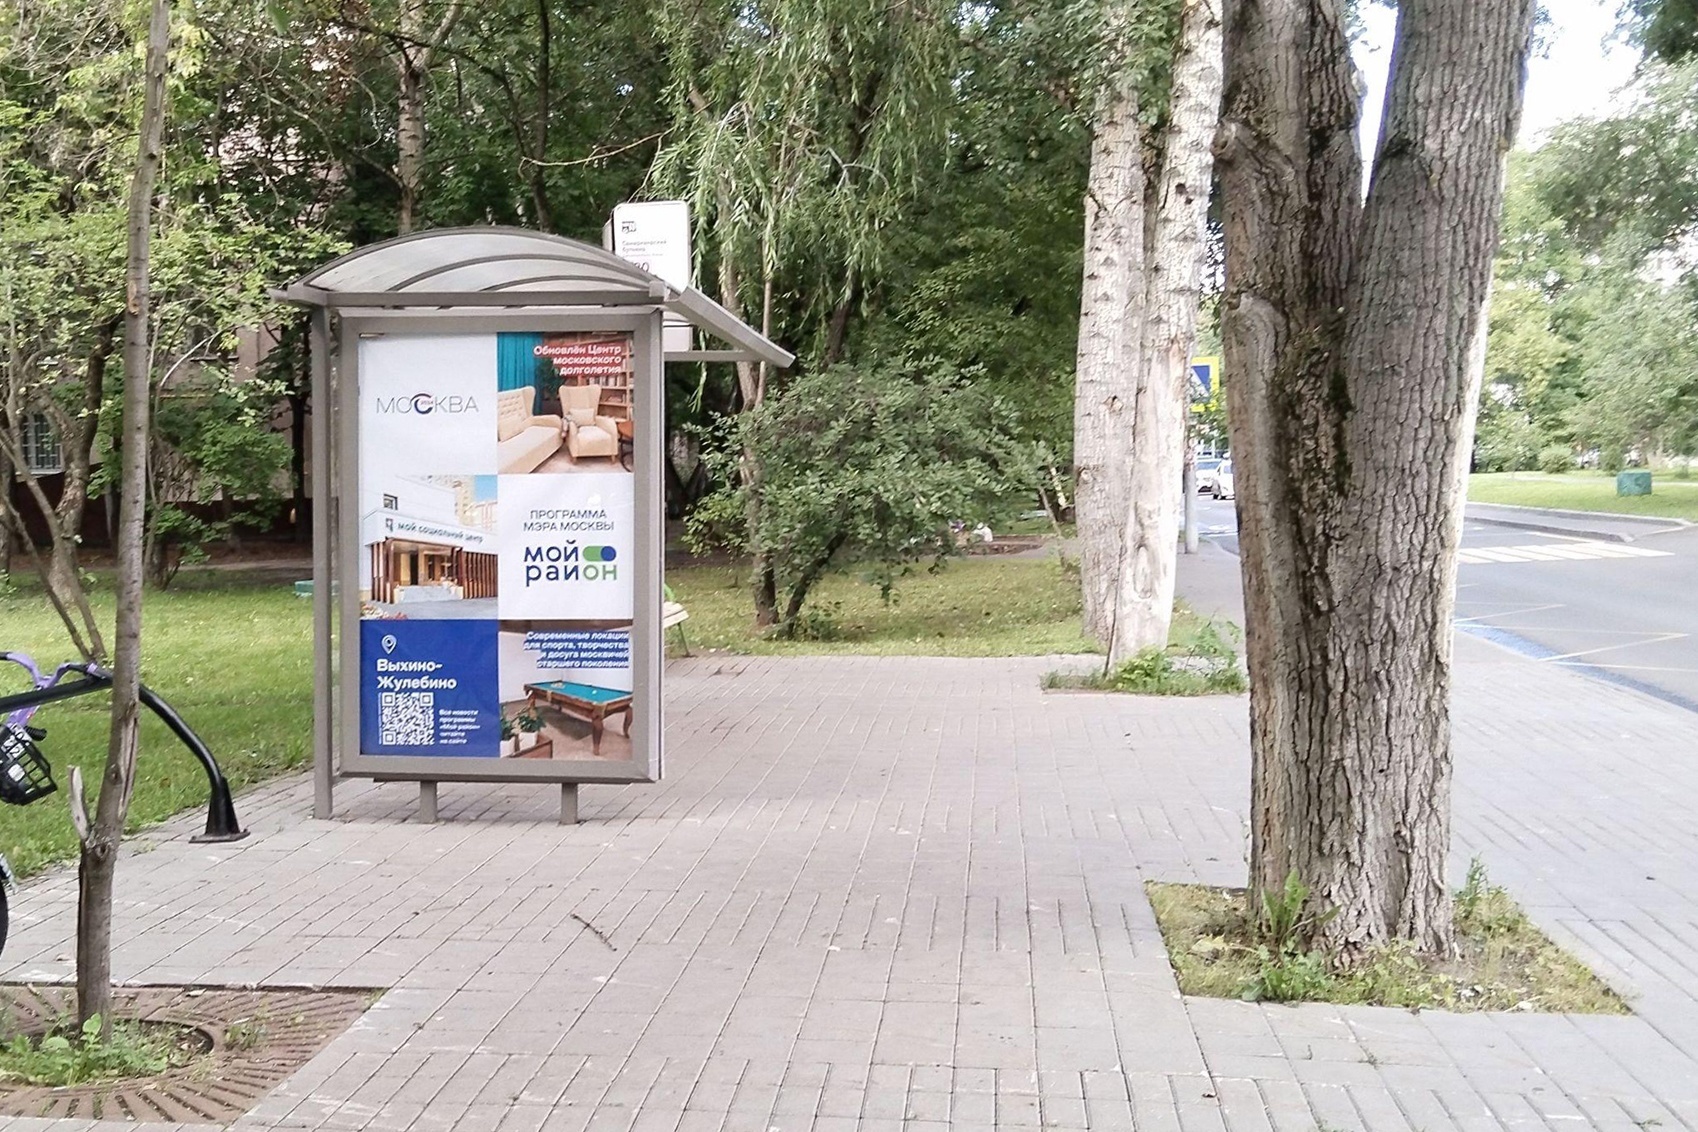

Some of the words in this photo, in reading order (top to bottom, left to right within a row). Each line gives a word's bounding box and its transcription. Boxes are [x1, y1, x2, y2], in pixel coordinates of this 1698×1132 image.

[533, 345, 586, 355] Обновлён
[587, 345, 621, 355] Центр
[553, 356, 621, 365] московского
[560, 366, 621, 376] долголетия
[376, 393, 480, 415] МОСКВА
[530, 509, 607, 520] ПРОГРАММА
[523, 521, 557, 531] МЭРА
[559, 521, 614, 531] МОСКВЫ
[524, 539, 579, 562] мой
[526, 631, 590, 641] Современные
[591, 632, 629, 641] локации
[524, 642, 540, 651] для
[577, 642, 629, 651] творчества
[548, 651, 579, 661] досуга
[580, 650, 629, 659] москвичей
[377, 658, 443, 672] Выхино-
[537, 660, 580, 669] старшего
[581, 660, 629, 668] поколения
[377, 675, 458, 692] Жулебино
